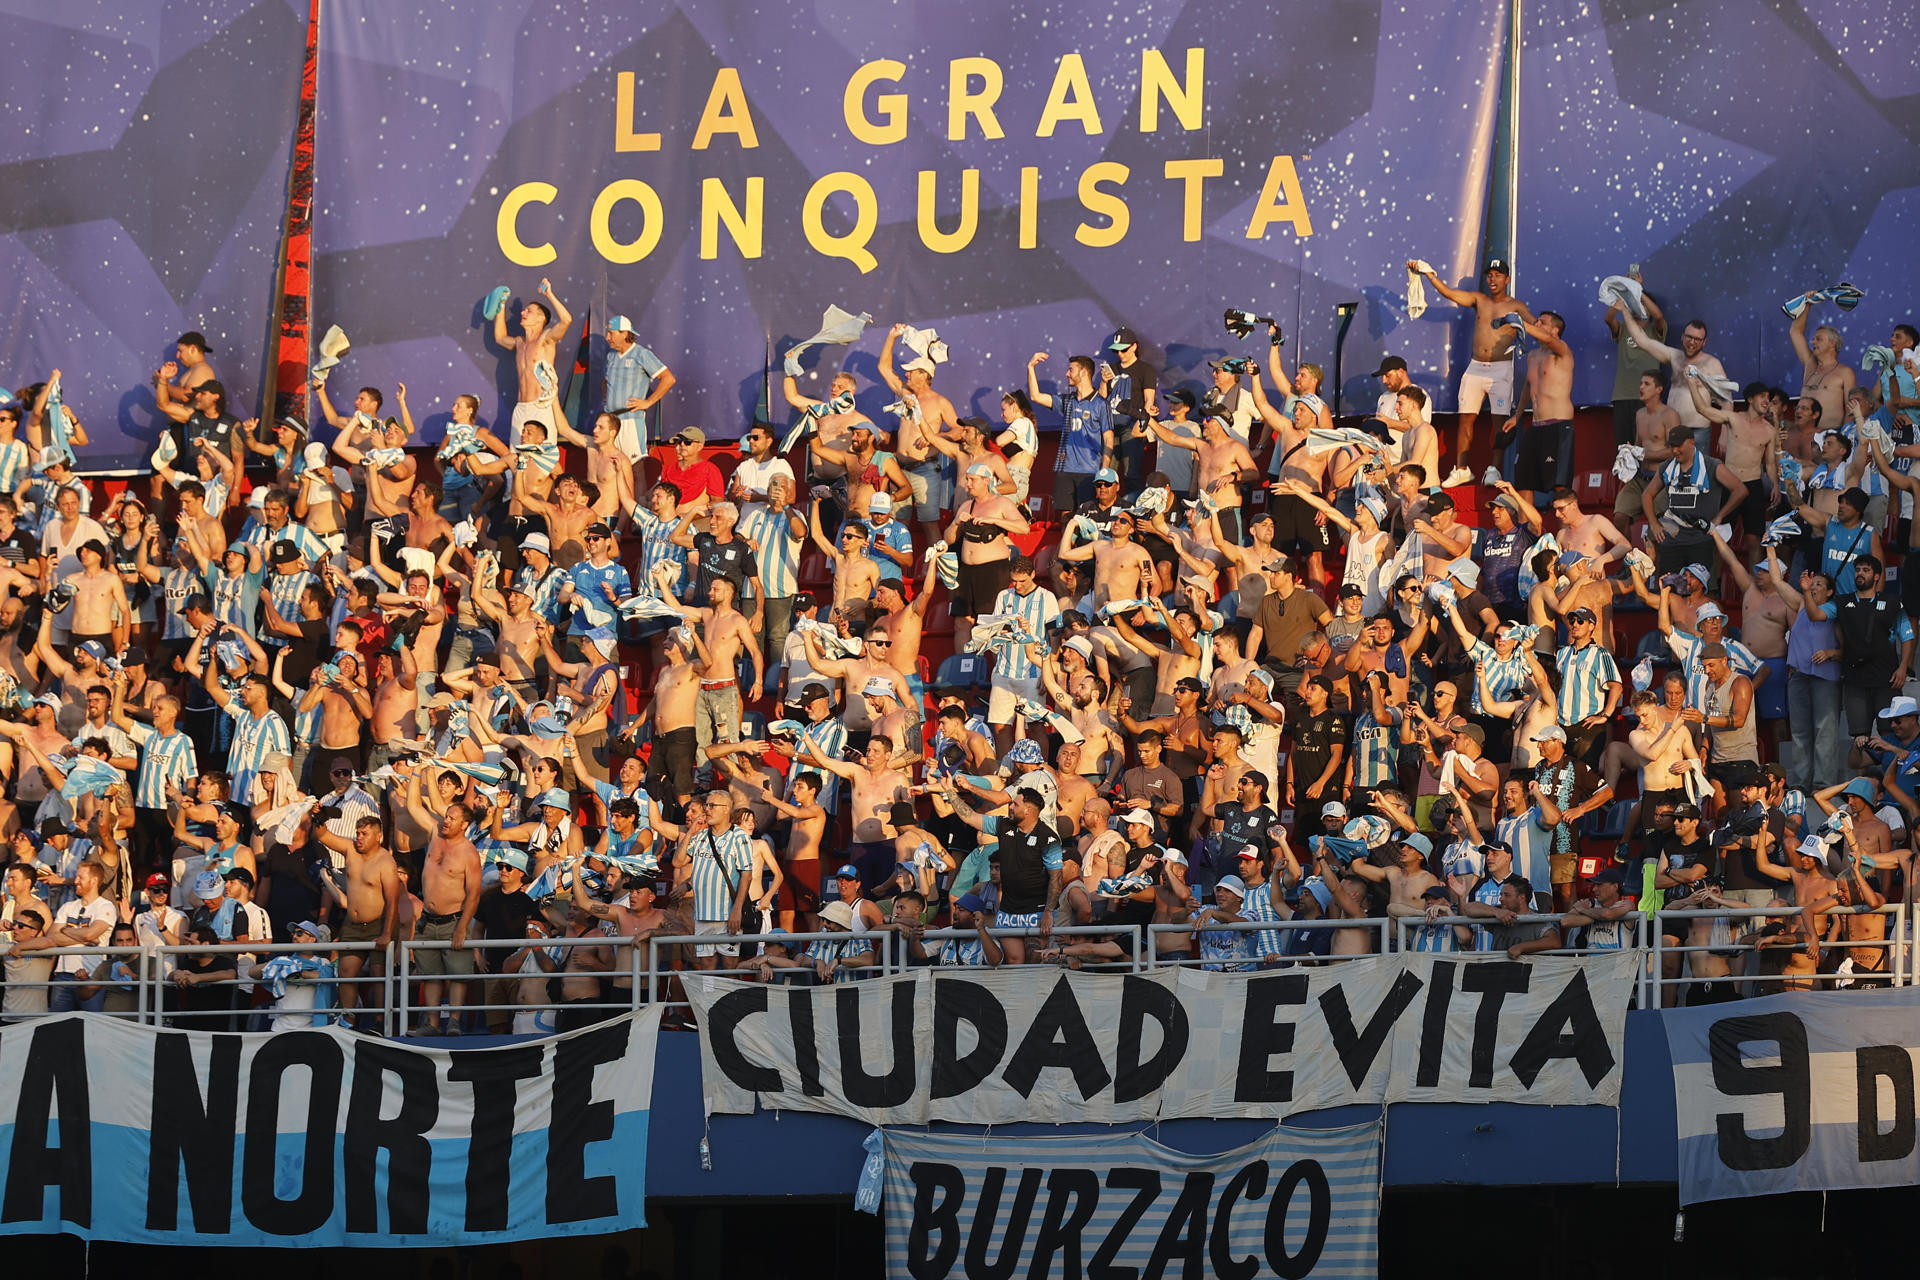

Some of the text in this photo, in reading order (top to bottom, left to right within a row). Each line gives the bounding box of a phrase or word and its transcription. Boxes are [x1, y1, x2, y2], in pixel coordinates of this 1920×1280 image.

[614, 47, 1205, 153] LA GRAN
[496, 155, 1314, 275] CONQUISTA
[1896, 457, 1910, 471] 10
[996, 913, 1038, 928] RACING
[708, 960, 1616, 1108] CIUDAD EVITA
[1709, 1011, 1916, 1171] 9 D
[145, 1018, 634, 1236] NORTE
[906, 1158, 1332, 1280] BURZACO
